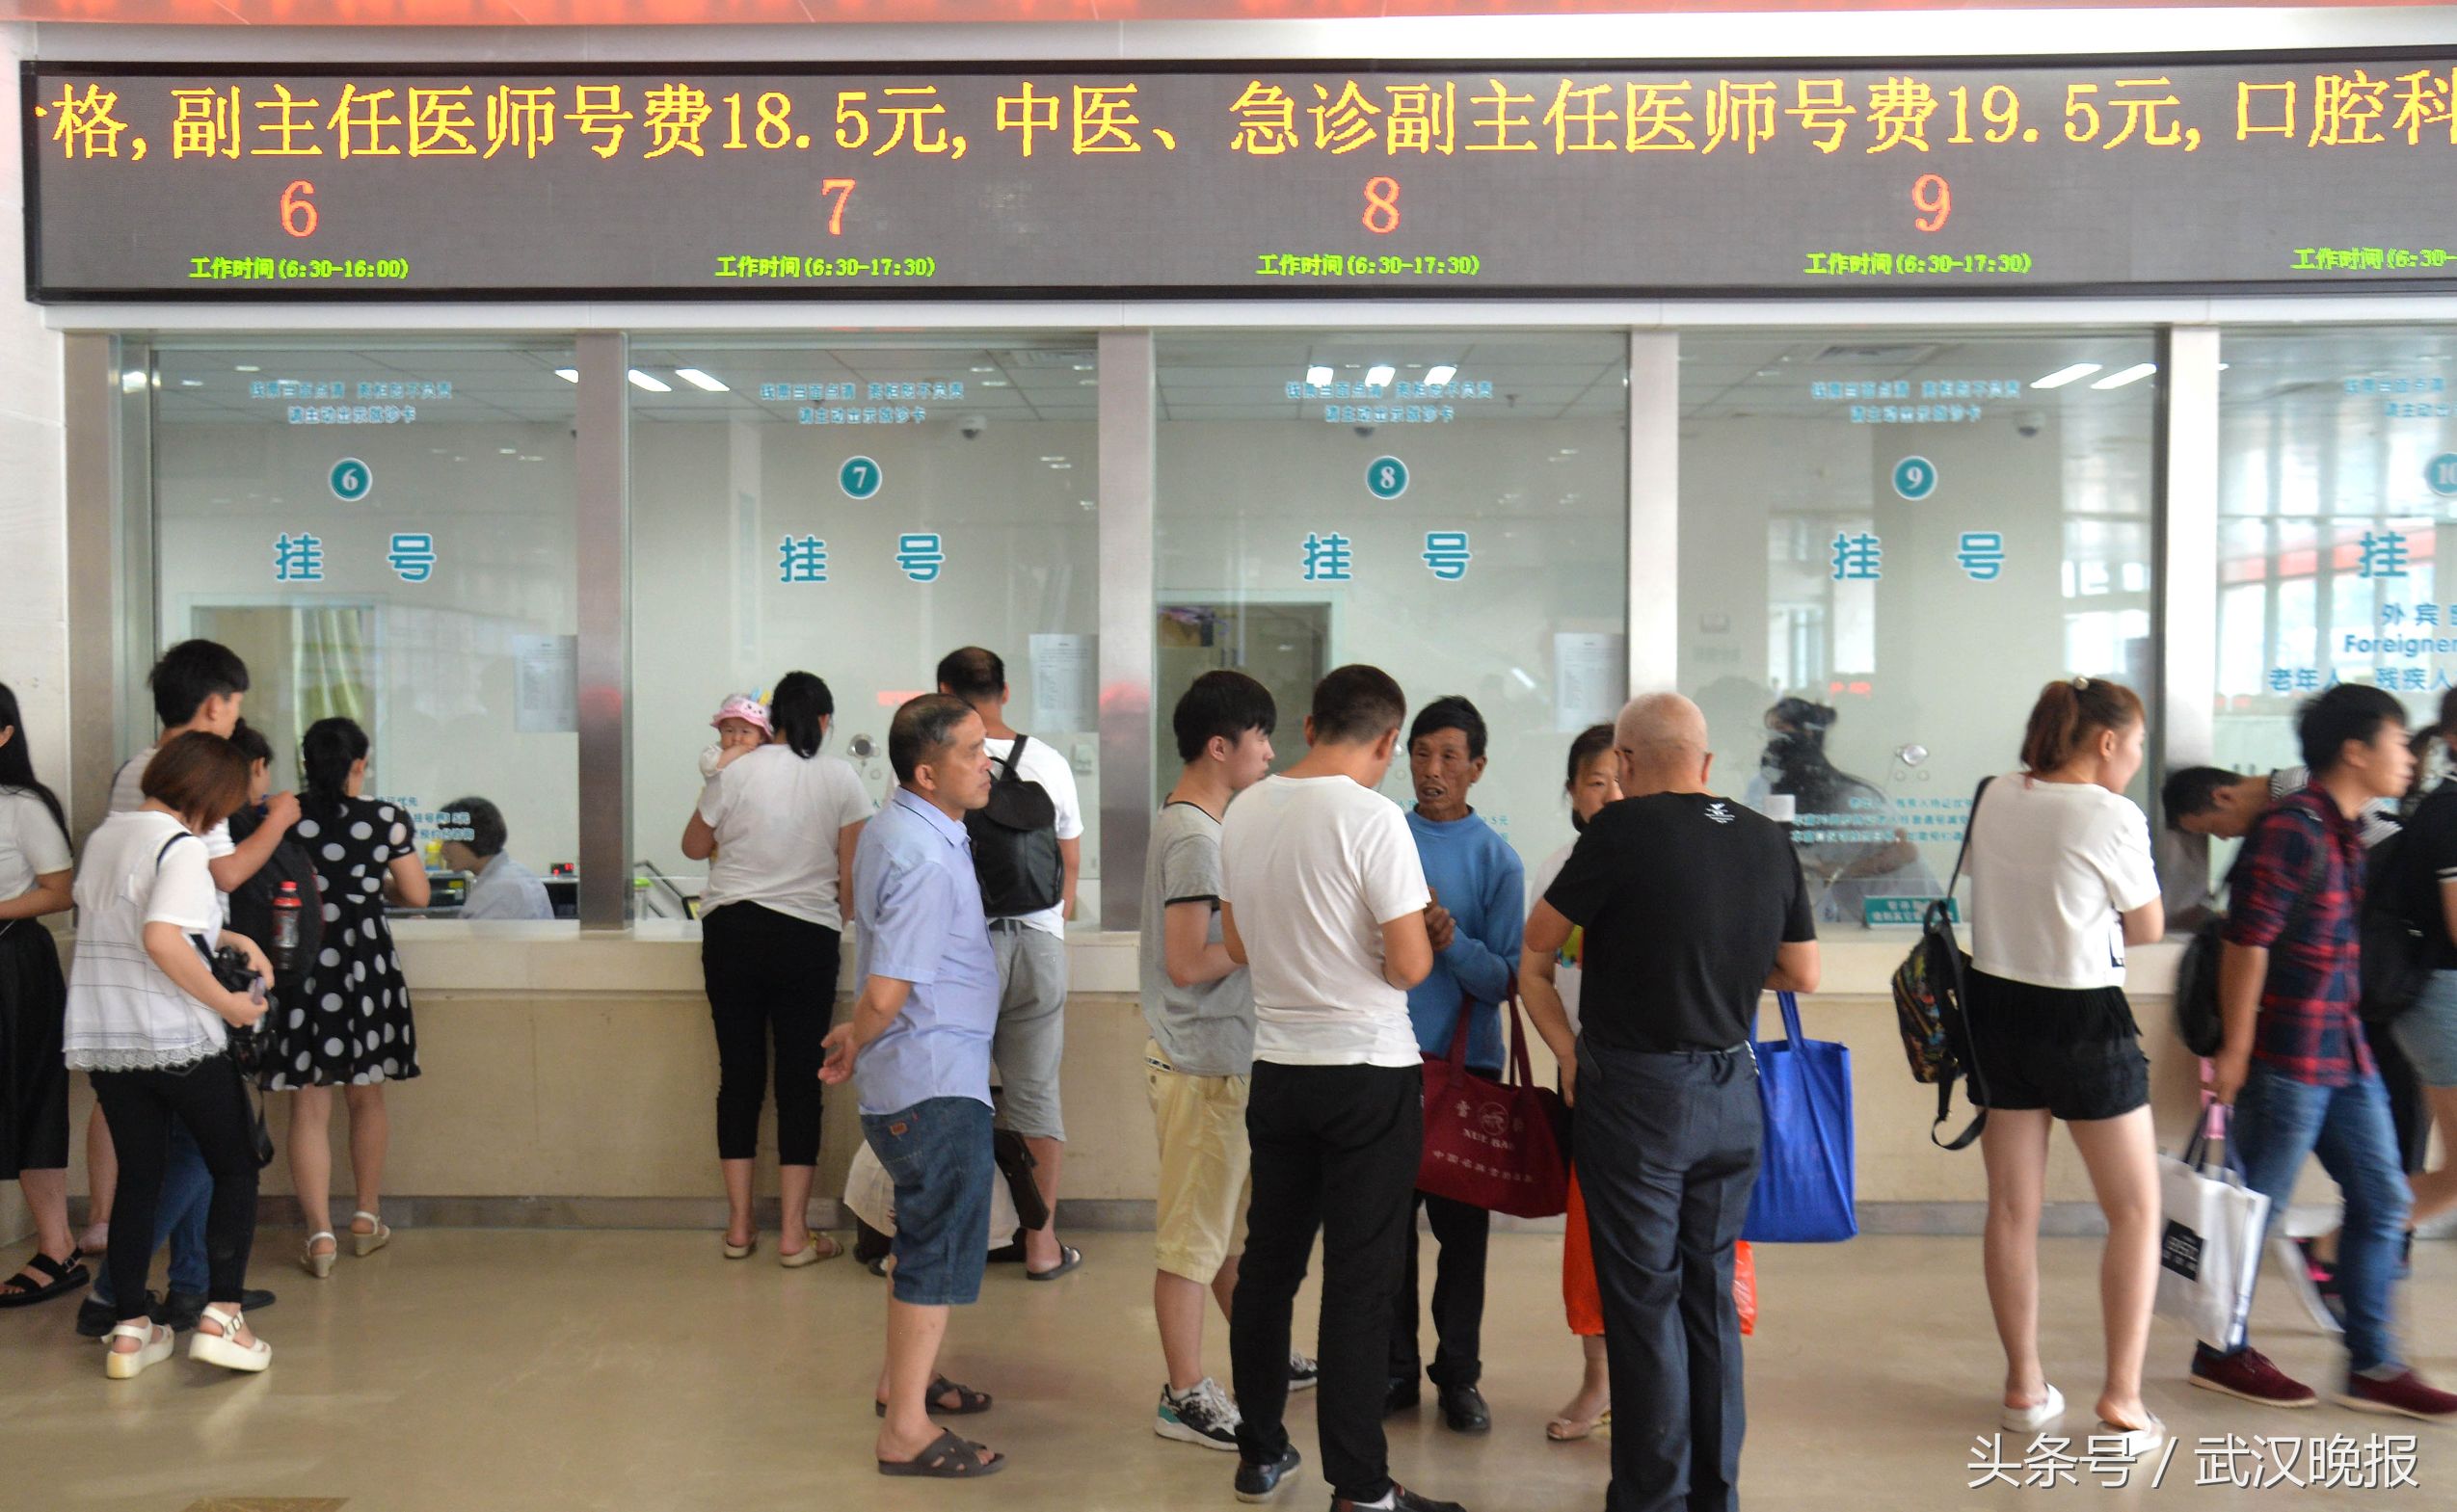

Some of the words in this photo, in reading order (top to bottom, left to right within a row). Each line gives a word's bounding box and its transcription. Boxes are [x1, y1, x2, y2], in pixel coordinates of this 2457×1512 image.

[34, 66, 2457, 162] 格,副主任医师号费18.5元,中医、急诊副主任医师号费19.5元,口腔科
[280, 179, 319, 238] 6
[822, 178, 856, 236] 7
[1362, 175, 1401, 234] 8
[1911, 172, 1951, 232] 9
[188, 255, 410, 280] 工作时间(6:30-16:00)
[714, 254, 936, 279] 工作时间(6:30-17:30)
[1256, 252, 1481, 278] 工作时间(6:30-17:30)
[1803, 251, 2032, 276] 工作时间(6:30-17:30)
[342, 468, 359, 491] 6
[852, 466, 868, 489] 7
[1380, 465, 1396, 489] 8
[1907, 466, 1923, 490] 9
[275, 533, 436, 582] 挂号
[779, 532, 944, 583] 挂号
[1302, 531, 1471, 582] 挂号
[1831, 531, 2005, 581] 挂号
[2359, 531, 2409, 579] 挂
[2376, 667, 2454, 691] 残疾人
